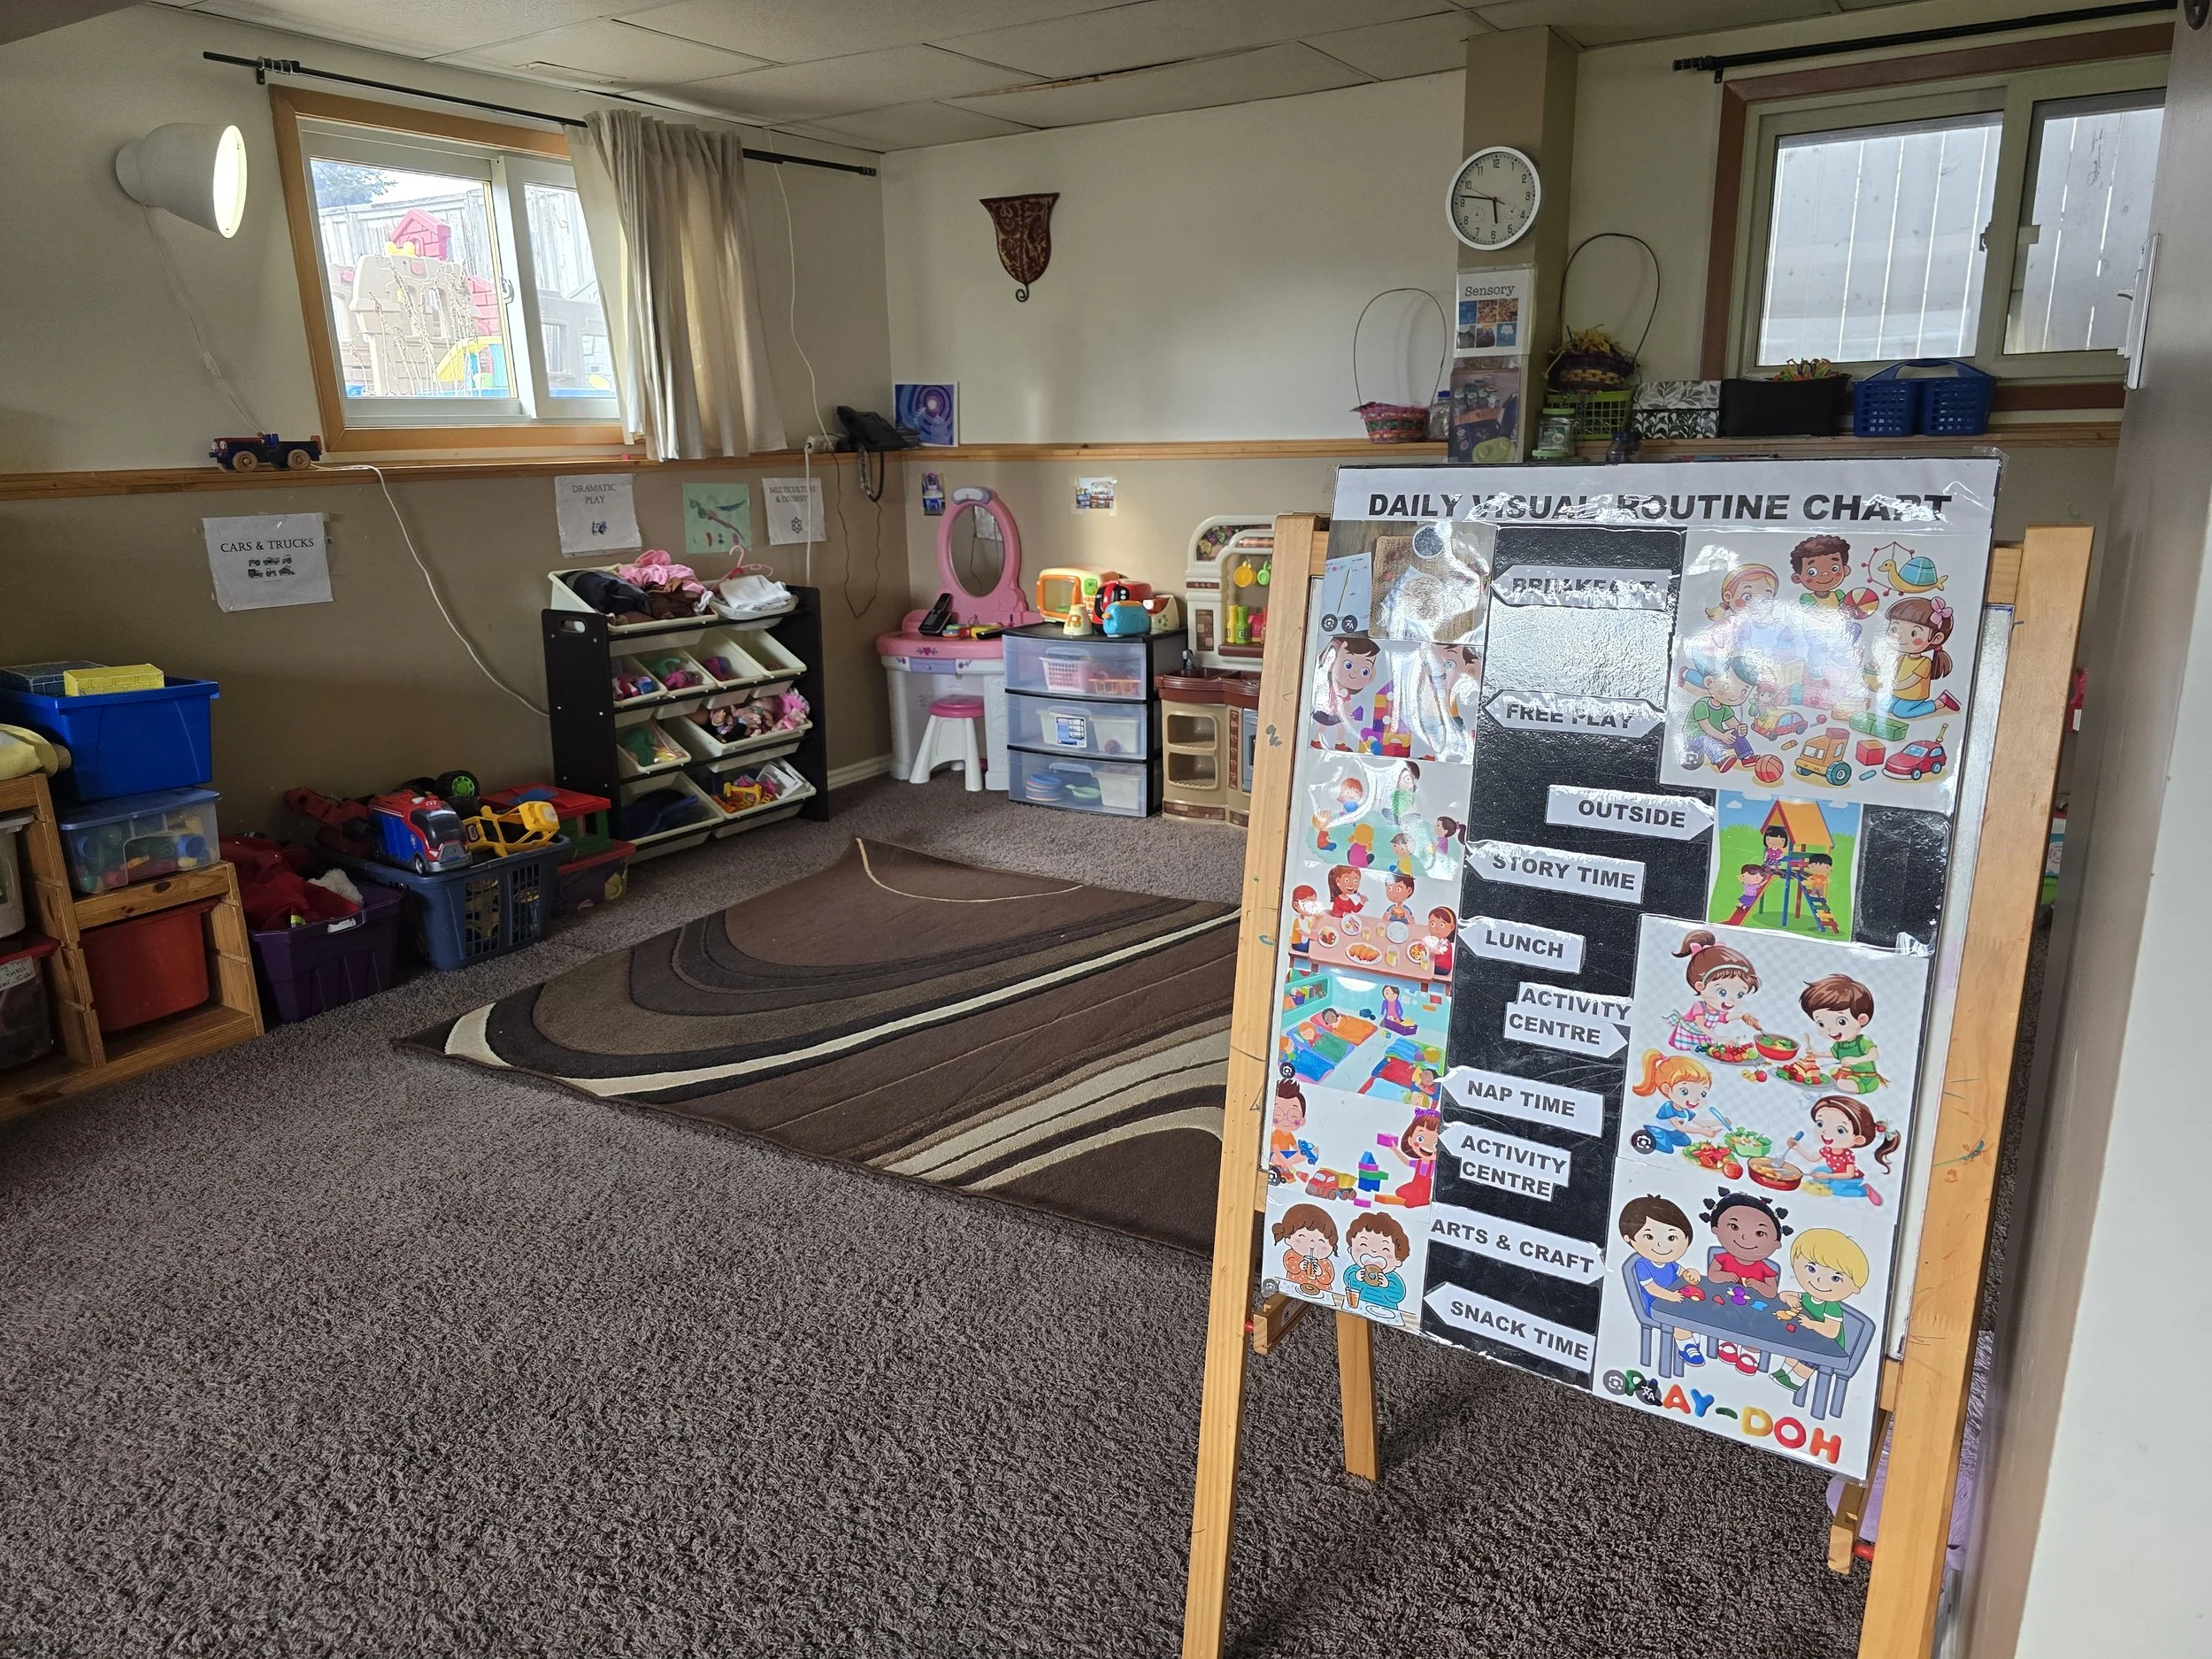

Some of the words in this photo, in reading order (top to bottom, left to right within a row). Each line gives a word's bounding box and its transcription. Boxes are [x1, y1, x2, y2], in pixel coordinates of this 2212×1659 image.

[1493, 159, 1500, 168] 12
[1511, 162, 1515, 171] 1
[1477, 165, 1484, 175] 11
[1522, 174, 1527, 183] 2
[1465, 180, 1472, 190] 10
[1525, 191, 1531, 201] 3
[1460, 198, 1465, 207] 9
[1520, 210, 1525, 219] 4
[1463, 216, 1469, 225] 8
[1475, 227, 1480, 236] 7
[1507, 224, 1512, 234] 5
[1491, 231, 1496, 240] 6
[1464, 285, 1516, 297] Sensory
[572, 483, 617, 493] DRAMATIC
[585, 495, 605, 504] PLAY
[1368, 494, 1463, 518] DAILY
[1472, 494, 1598, 519] VISUAL
[1617, 494, 1790, 520] ROUTINE
[220, 541, 252, 553] CARS
[256, 541, 265, 550] &
[267, 538, 314, 549] TRUCKS
[1506, 703, 1563, 724] FREE
[1578, 799, 1686, 828] OUTSIDE
[1493, 856, 1571, 879] STORY
[1578, 866, 1635, 890] TIME
[1486, 930, 1563, 958] LUNCH
[1522, 987, 1632, 1020] ACTIVITY
[1509, 1013, 1601, 1045] CENTRE
[1468, 1079, 1513, 1102] NAP
[1520, 1091, 1576, 1118] TIME
[1461, 1135, 1567, 1174] ACTIVITY
[1462, 1163, 1551, 1197] CENTRE
[1431, 1218, 1488, 1244] ARTS
[1496, 1234, 1511, 1251] &
[1519, 1240, 1594, 1273] CRAFT
[1450, 1301, 1527, 1339] SNACK
[1533, 1327, 1589, 1362] TIME
